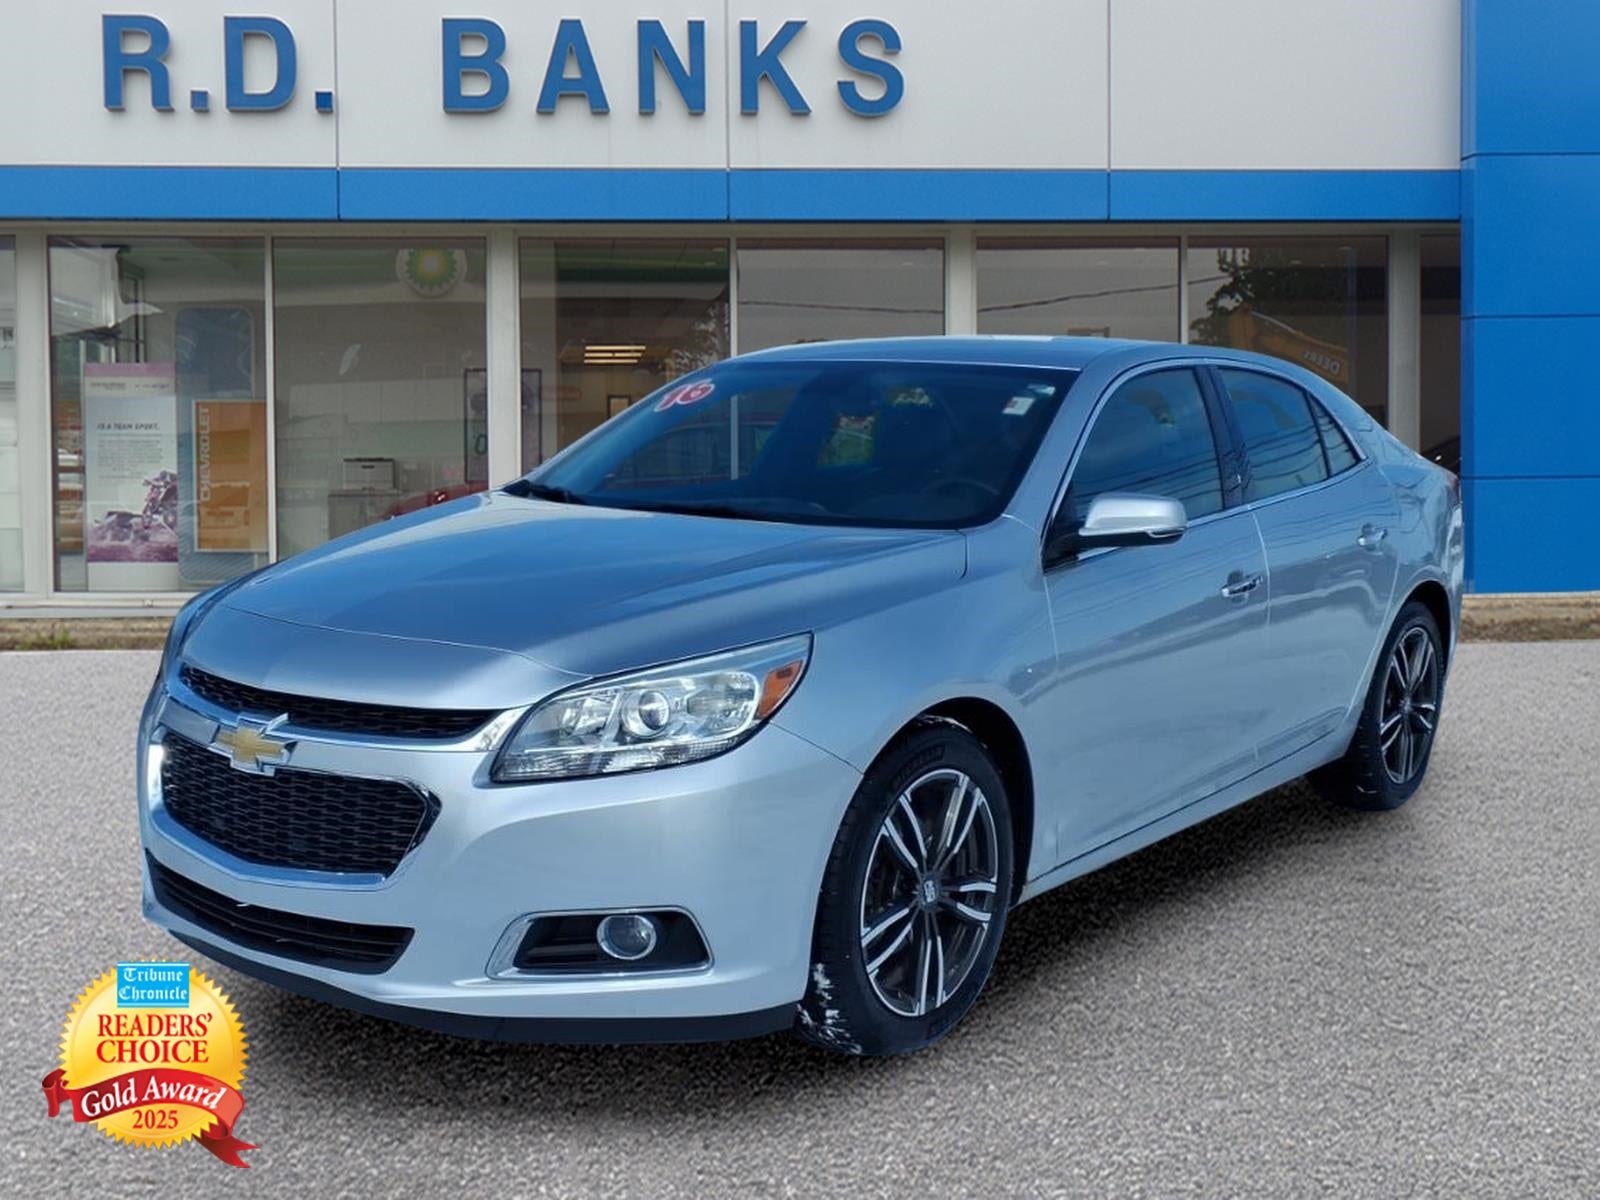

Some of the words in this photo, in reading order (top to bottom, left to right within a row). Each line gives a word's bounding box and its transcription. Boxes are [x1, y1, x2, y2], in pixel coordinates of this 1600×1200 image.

[102, 15, 334, 112] R.D.
[442, 18, 905, 117] BANKS
[113, 422, 133, 430] TEAM
[199, 406, 211, 501] CHEVROLET
